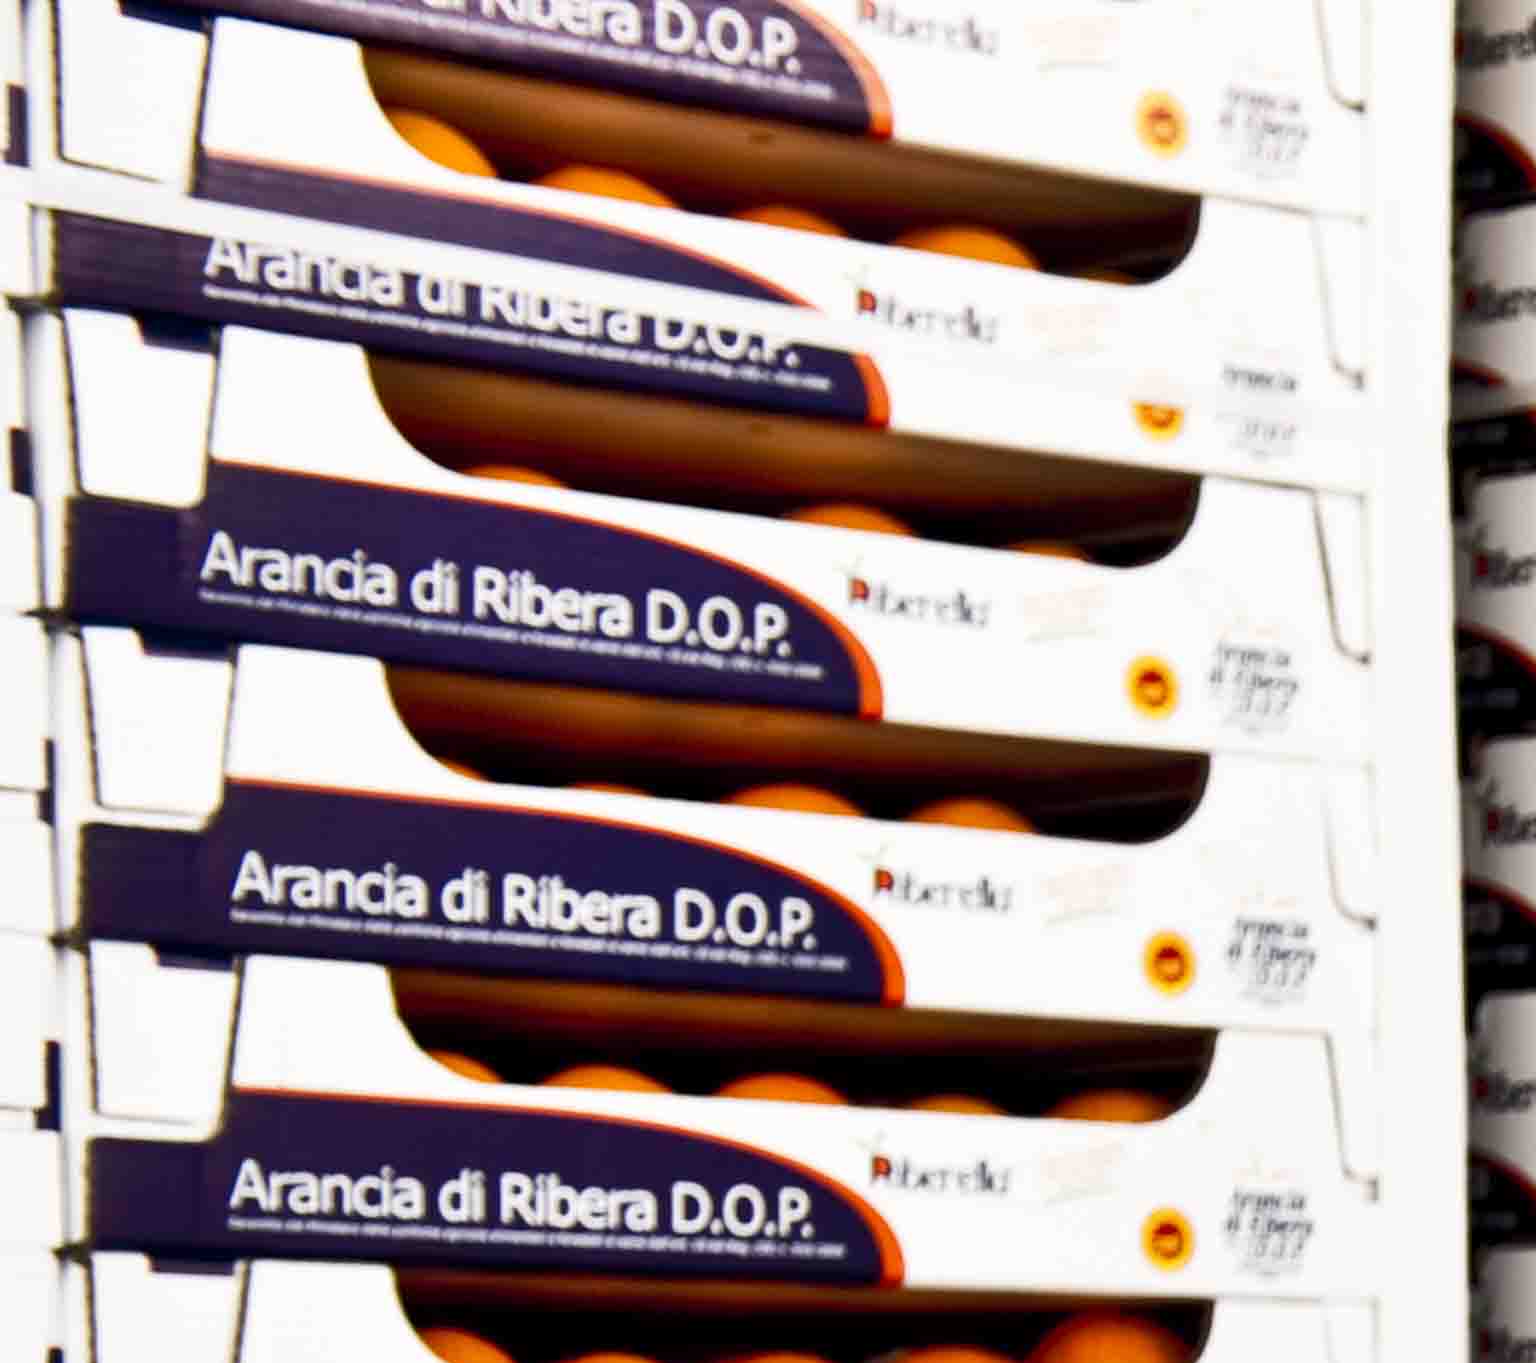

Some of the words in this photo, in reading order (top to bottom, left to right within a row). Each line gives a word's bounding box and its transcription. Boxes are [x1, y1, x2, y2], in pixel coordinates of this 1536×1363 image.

[201, 531, 397, 606] Arancia
[411, 559, 458, 614] di
[474, 565, 633, 638] Ribera
[647, 588, 790, 657] D.O.P.
[232, 850, 428, 918] Arancia
[441, 867, 488, 923] di
[503, 872, 660, 938] Ribera
[674, 888, 816, 950] D.O.P.
[230, 1158, 425, 1220] Arancia
[438, 1168, 485, 1223] di
[500, 1172, 657, 1233] Ribera
[672, 1181, 813, 1238] D.O.P.
